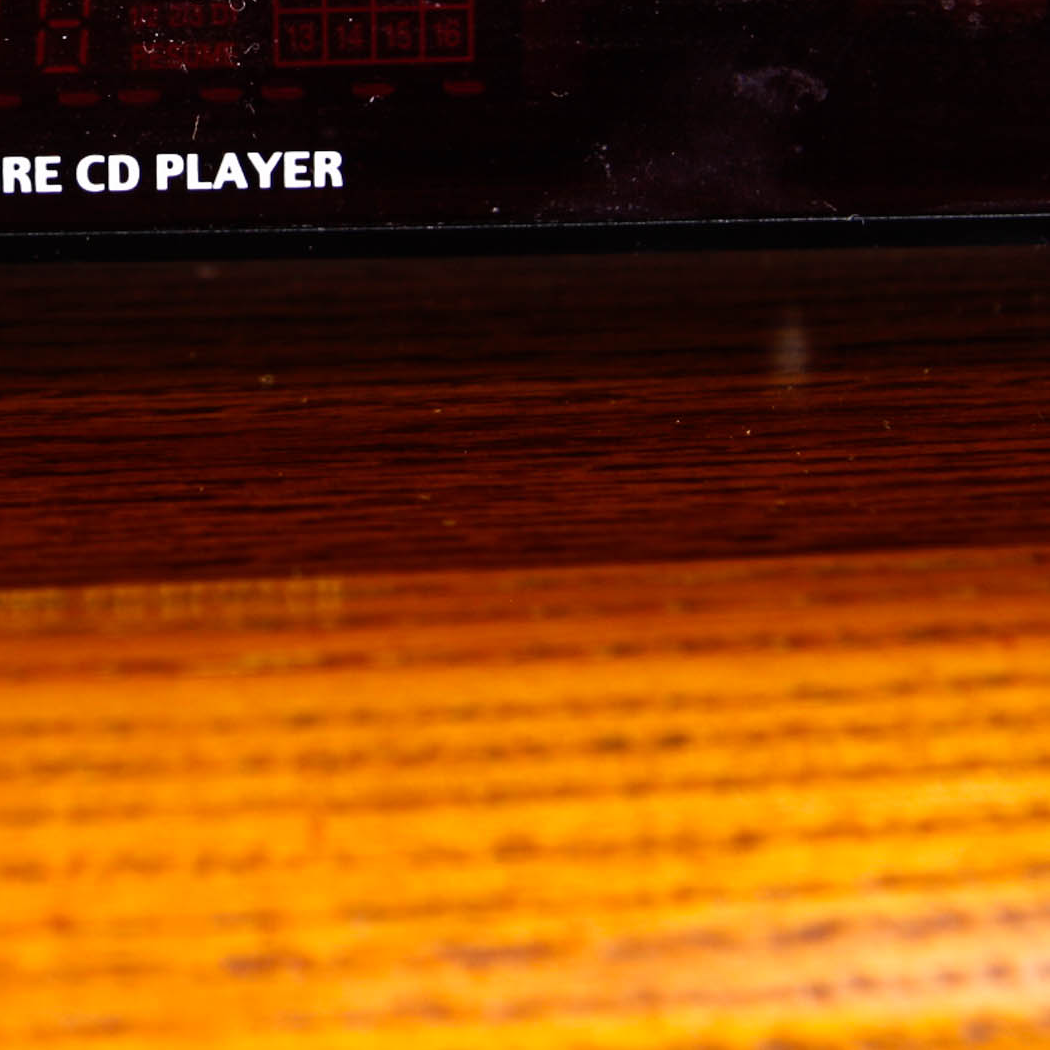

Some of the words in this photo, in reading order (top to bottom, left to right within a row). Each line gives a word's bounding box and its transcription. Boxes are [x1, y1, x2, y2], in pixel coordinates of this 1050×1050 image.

[285, 21, 315, 51] 13
[336, 21, 366, 50] 14
[382, 19, 413, 50] 15
[432, 18, 462, 48] 16
[75, 155, 140, 192] CD
[156, 151, 344, 190] PLAYER
